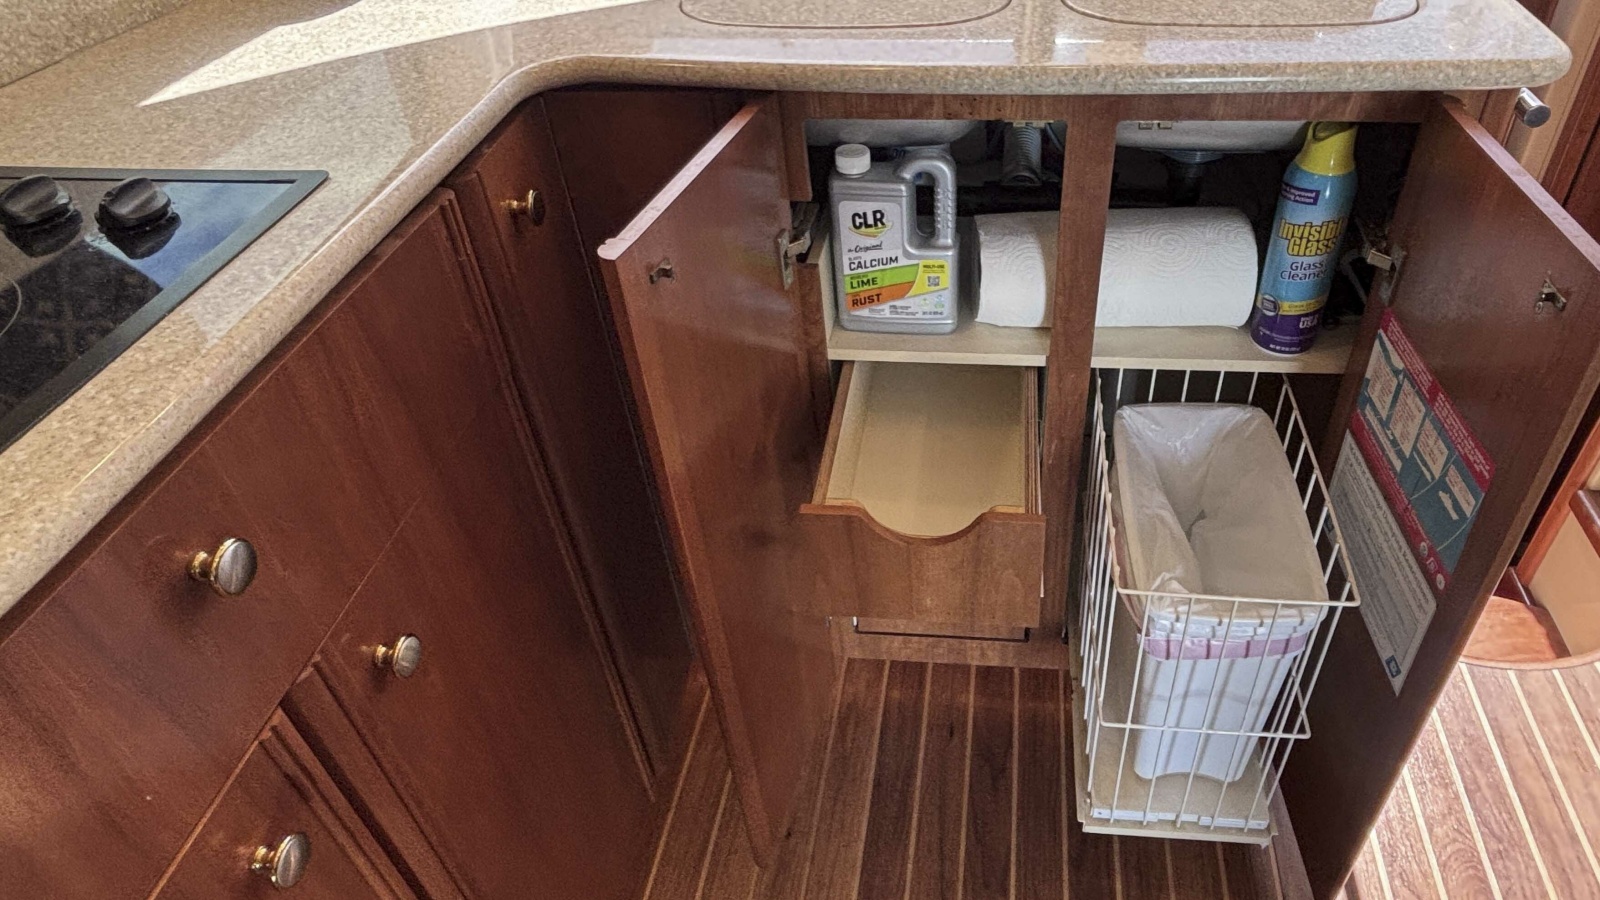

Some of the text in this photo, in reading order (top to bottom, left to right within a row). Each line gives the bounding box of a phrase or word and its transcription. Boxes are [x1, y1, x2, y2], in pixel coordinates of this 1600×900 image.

[852, 209, 886, 230] CLR
[854, 241, 883, 253] Original
[1288, 236, 1336, 257] Glass
[849, 256, 899, 272] CALCIUM
[1290, 261, 1323, 272] Glass
[1280, 268, 1327, 281] Cleaner
[850, 277, 879, 290] LIME
[852, 293, 882, 307] RUST
